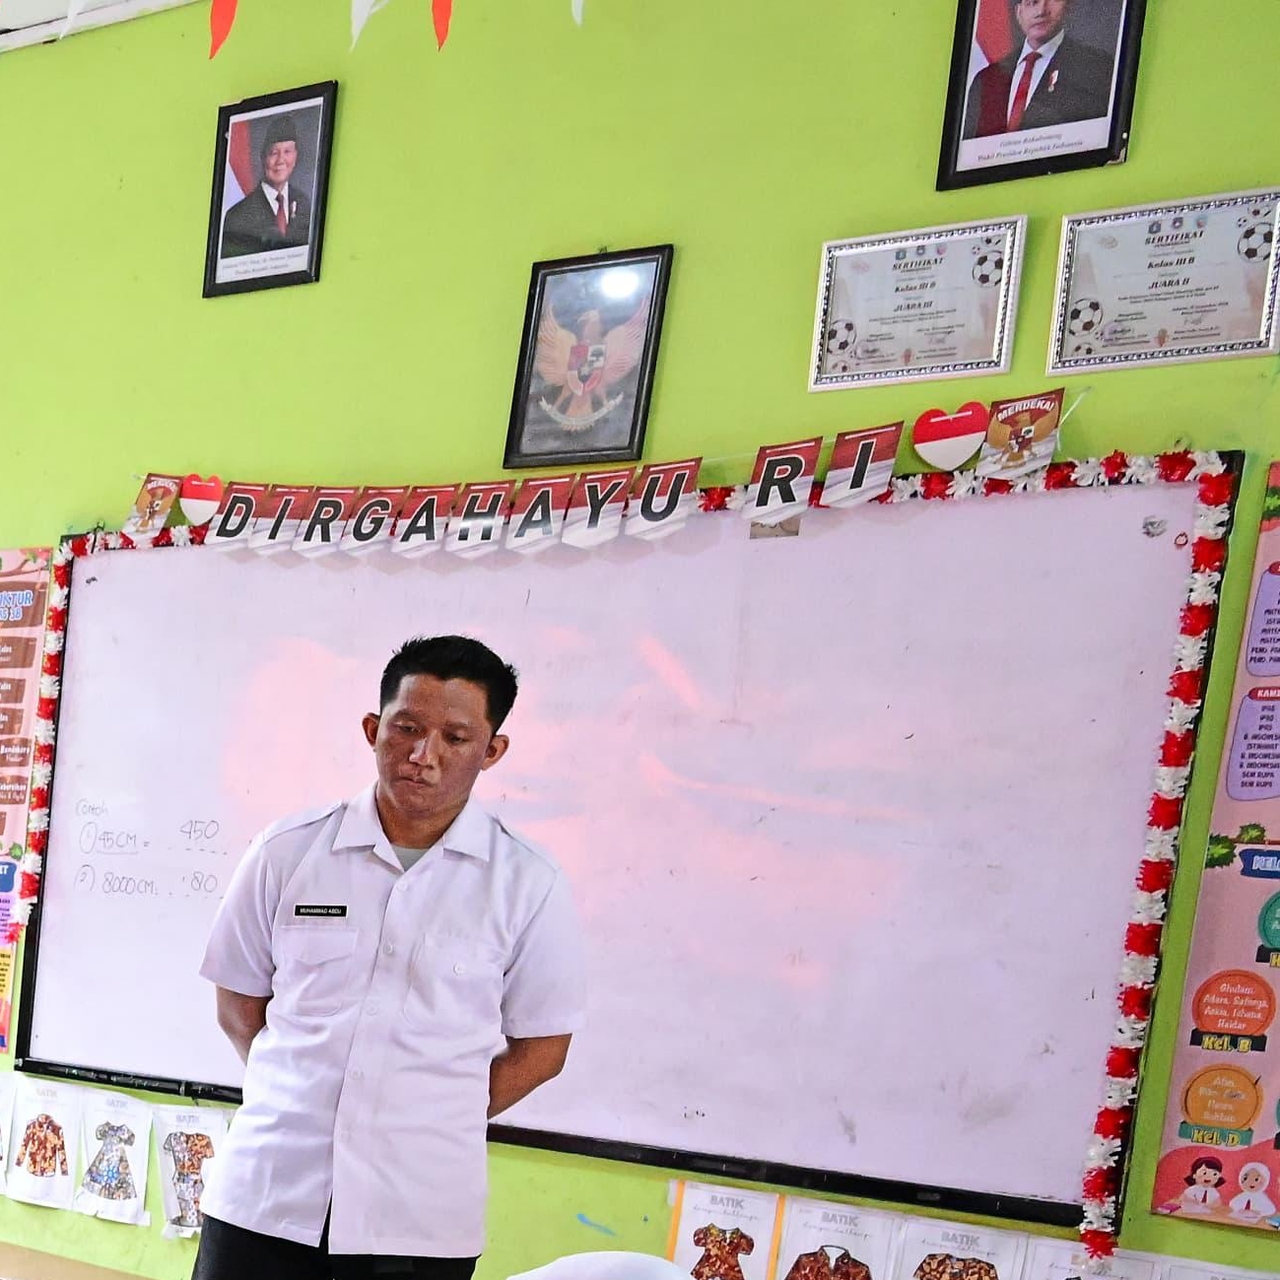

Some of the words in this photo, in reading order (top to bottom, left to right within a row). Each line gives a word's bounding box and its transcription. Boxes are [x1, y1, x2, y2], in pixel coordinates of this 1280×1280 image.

[216, 471, 690, 543] DIRGAHAYU
[1257, 689, 1280, 698] KAMI
[180, 820, 219, 840] 450
[191, 871, 218, 892] 80
[710, 1194, 744, 1209] BATIK
[821, 1211, 860, 1227] BATIK
[940, 1230, 980, 1248] BATIK
